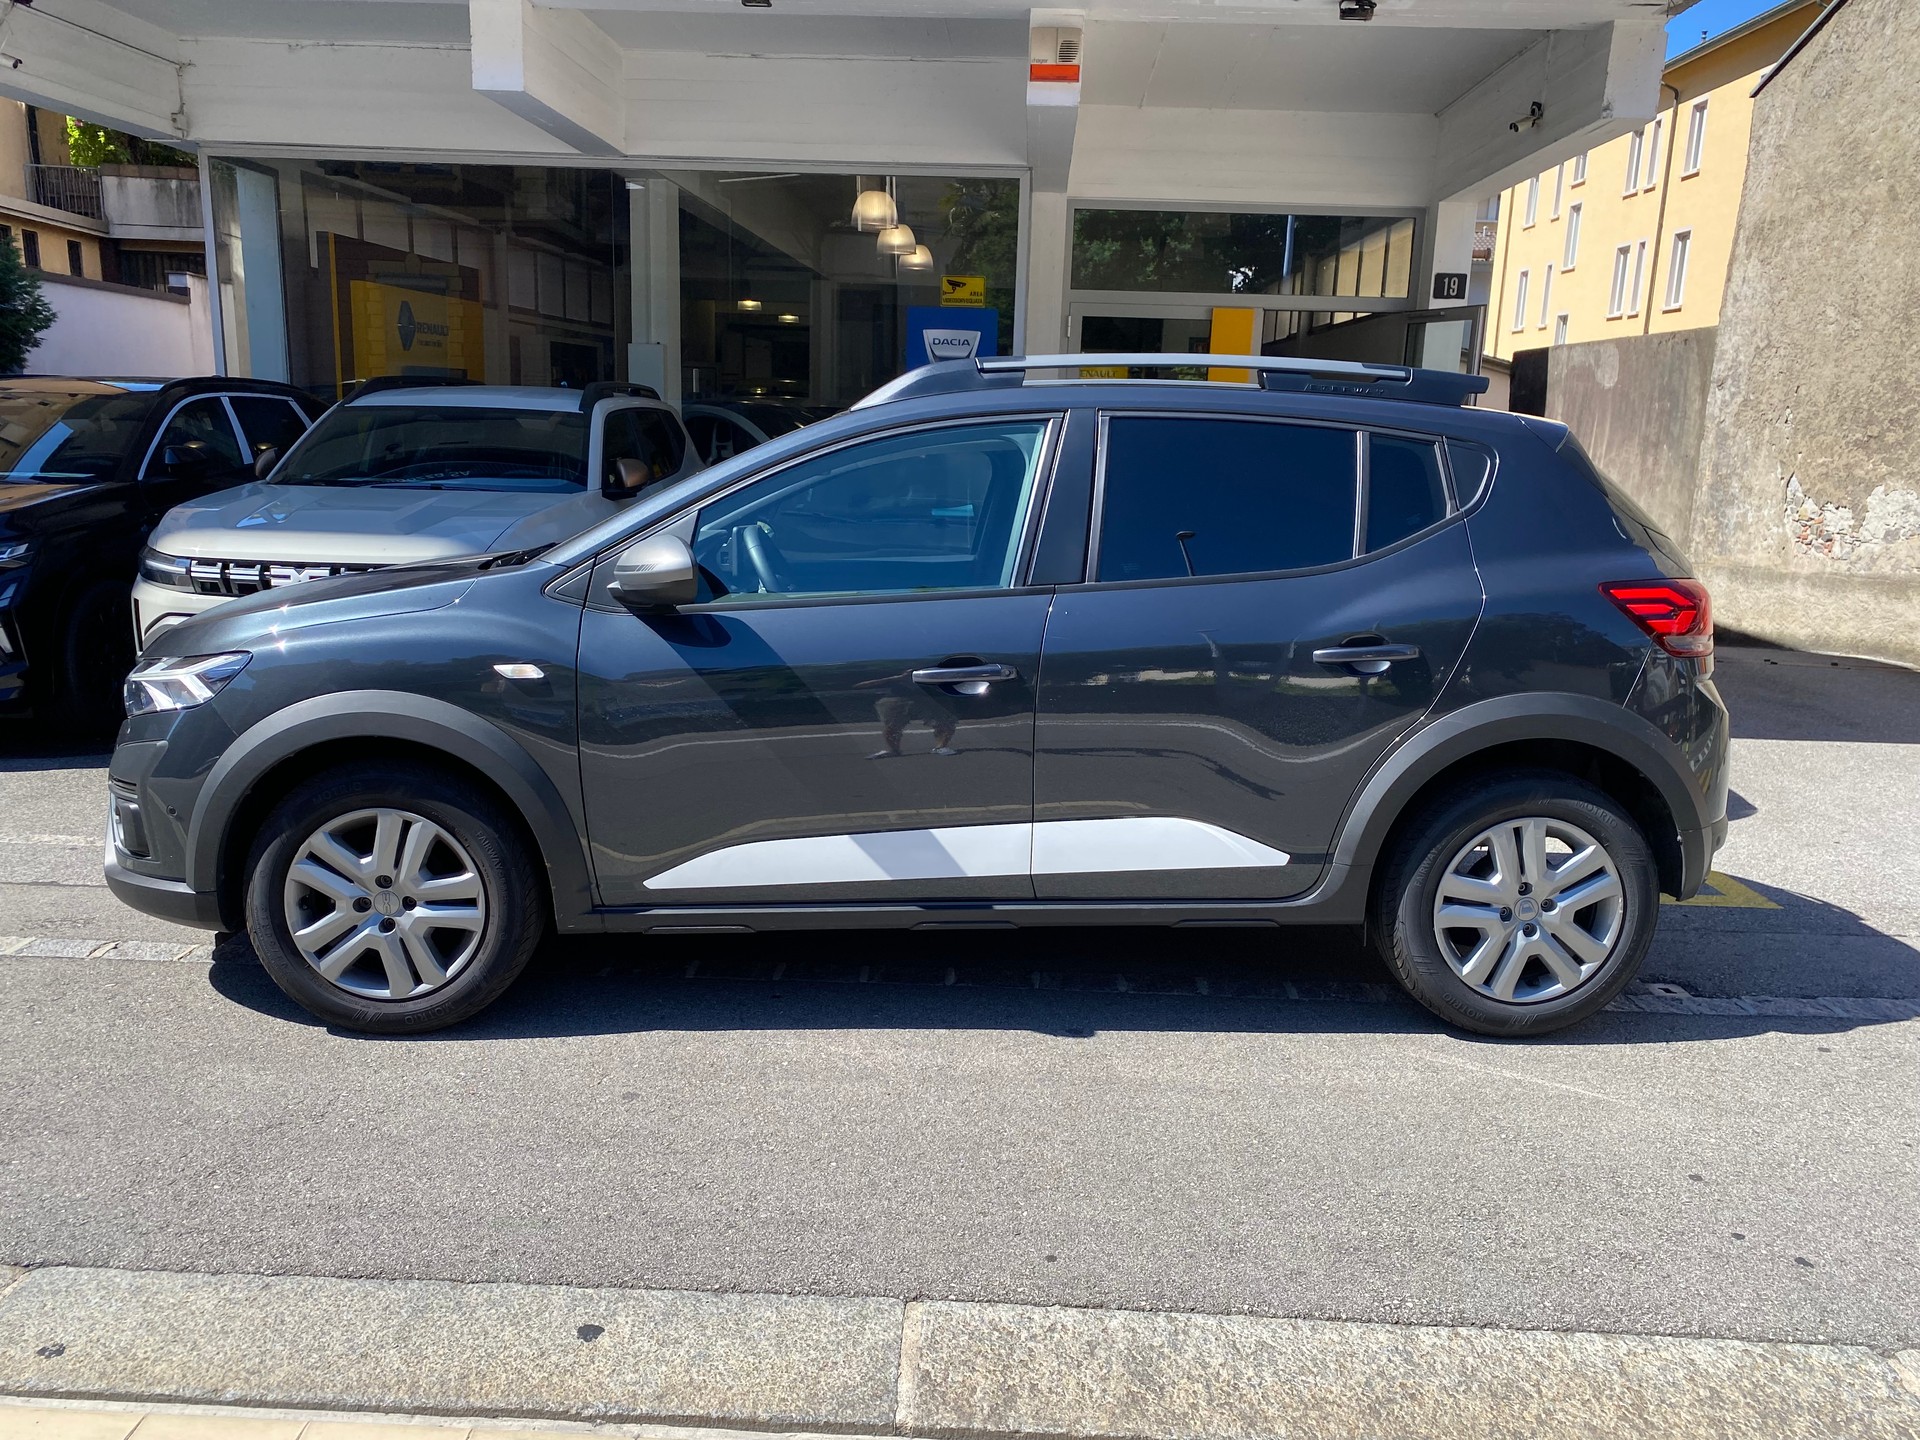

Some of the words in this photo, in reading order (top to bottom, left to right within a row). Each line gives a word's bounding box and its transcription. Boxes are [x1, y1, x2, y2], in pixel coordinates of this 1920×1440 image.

[1444, 276, 1459, 296] 19
[416, 321, 449, 337] RENAULT
[932, 337, 971, 347] DACIA
[1079, 369, 1118, 379] ENAULT
[1414, 847, 1439, 888] FAIRWAY
[1442, 992, 1487, 1024] MOTRIO
